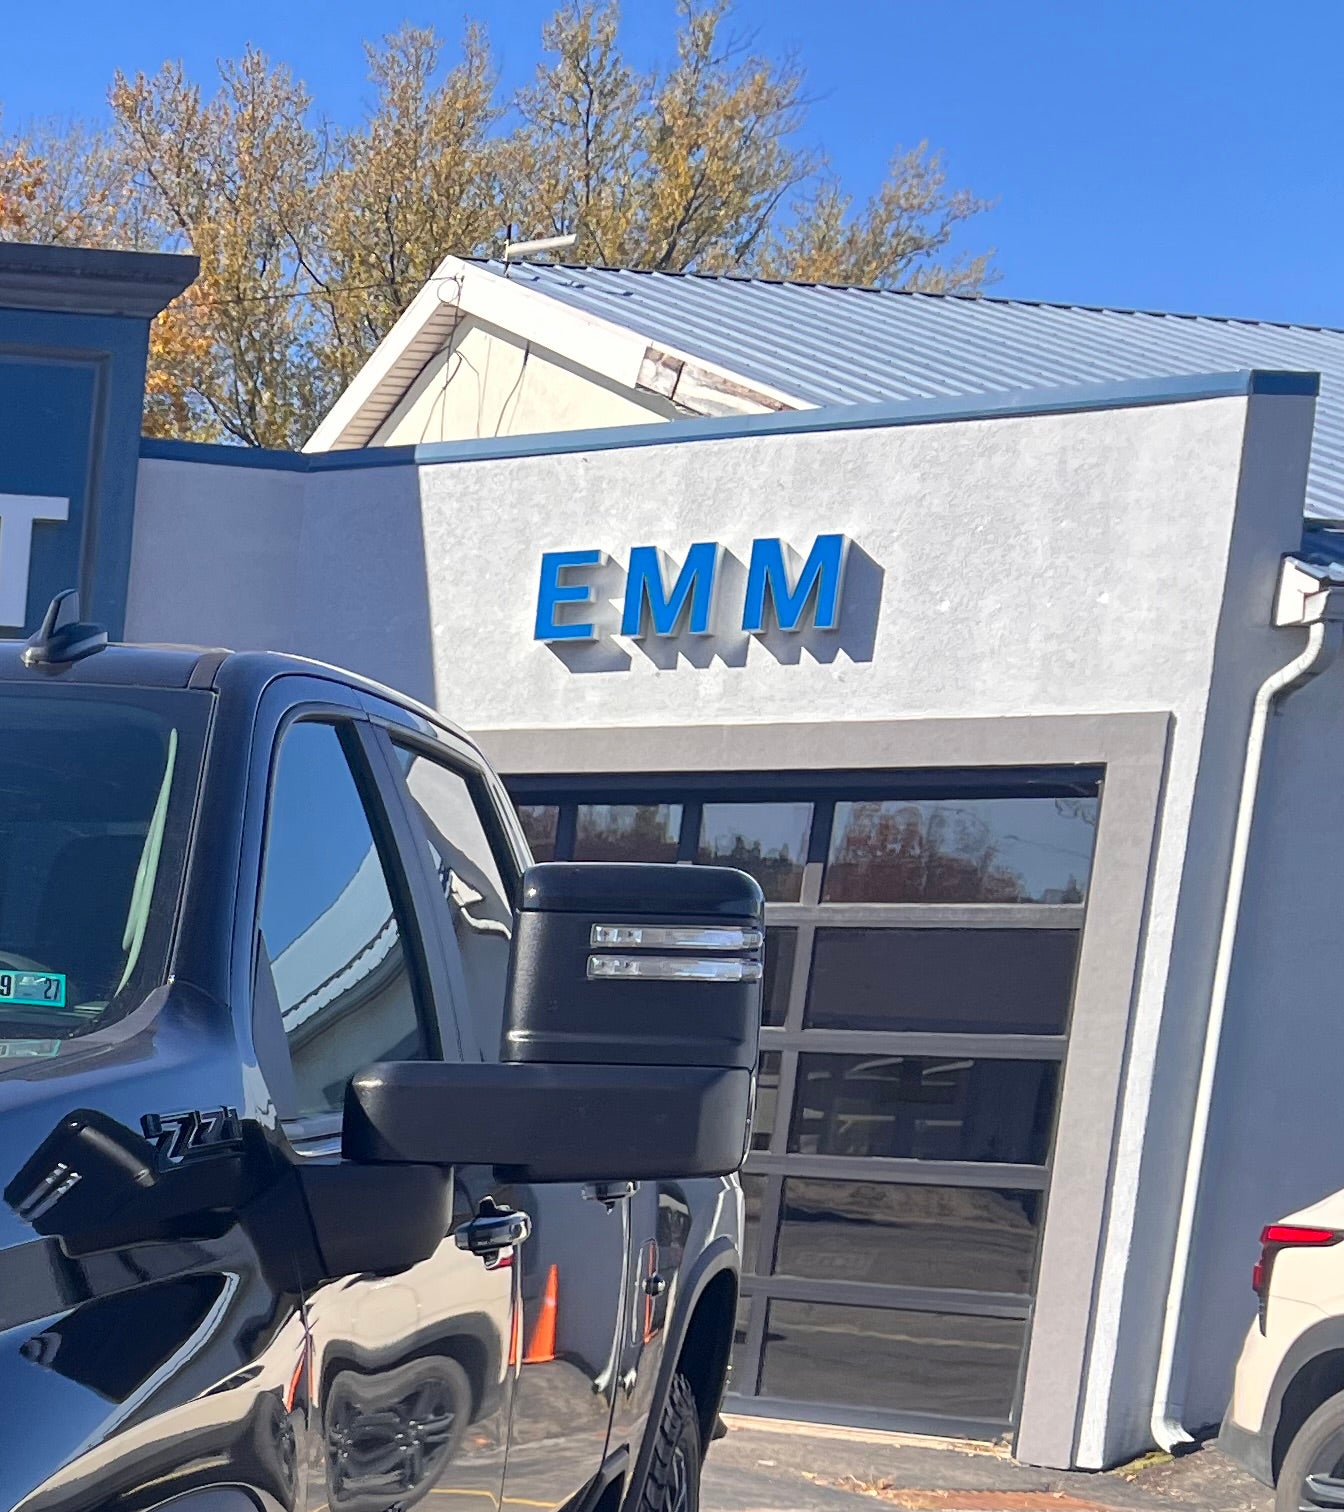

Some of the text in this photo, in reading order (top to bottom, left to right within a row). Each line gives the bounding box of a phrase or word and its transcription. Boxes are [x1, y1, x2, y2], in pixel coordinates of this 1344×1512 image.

[533, 532, 853, 642] EMM
[0, 974, 61, 1000] 9 27
